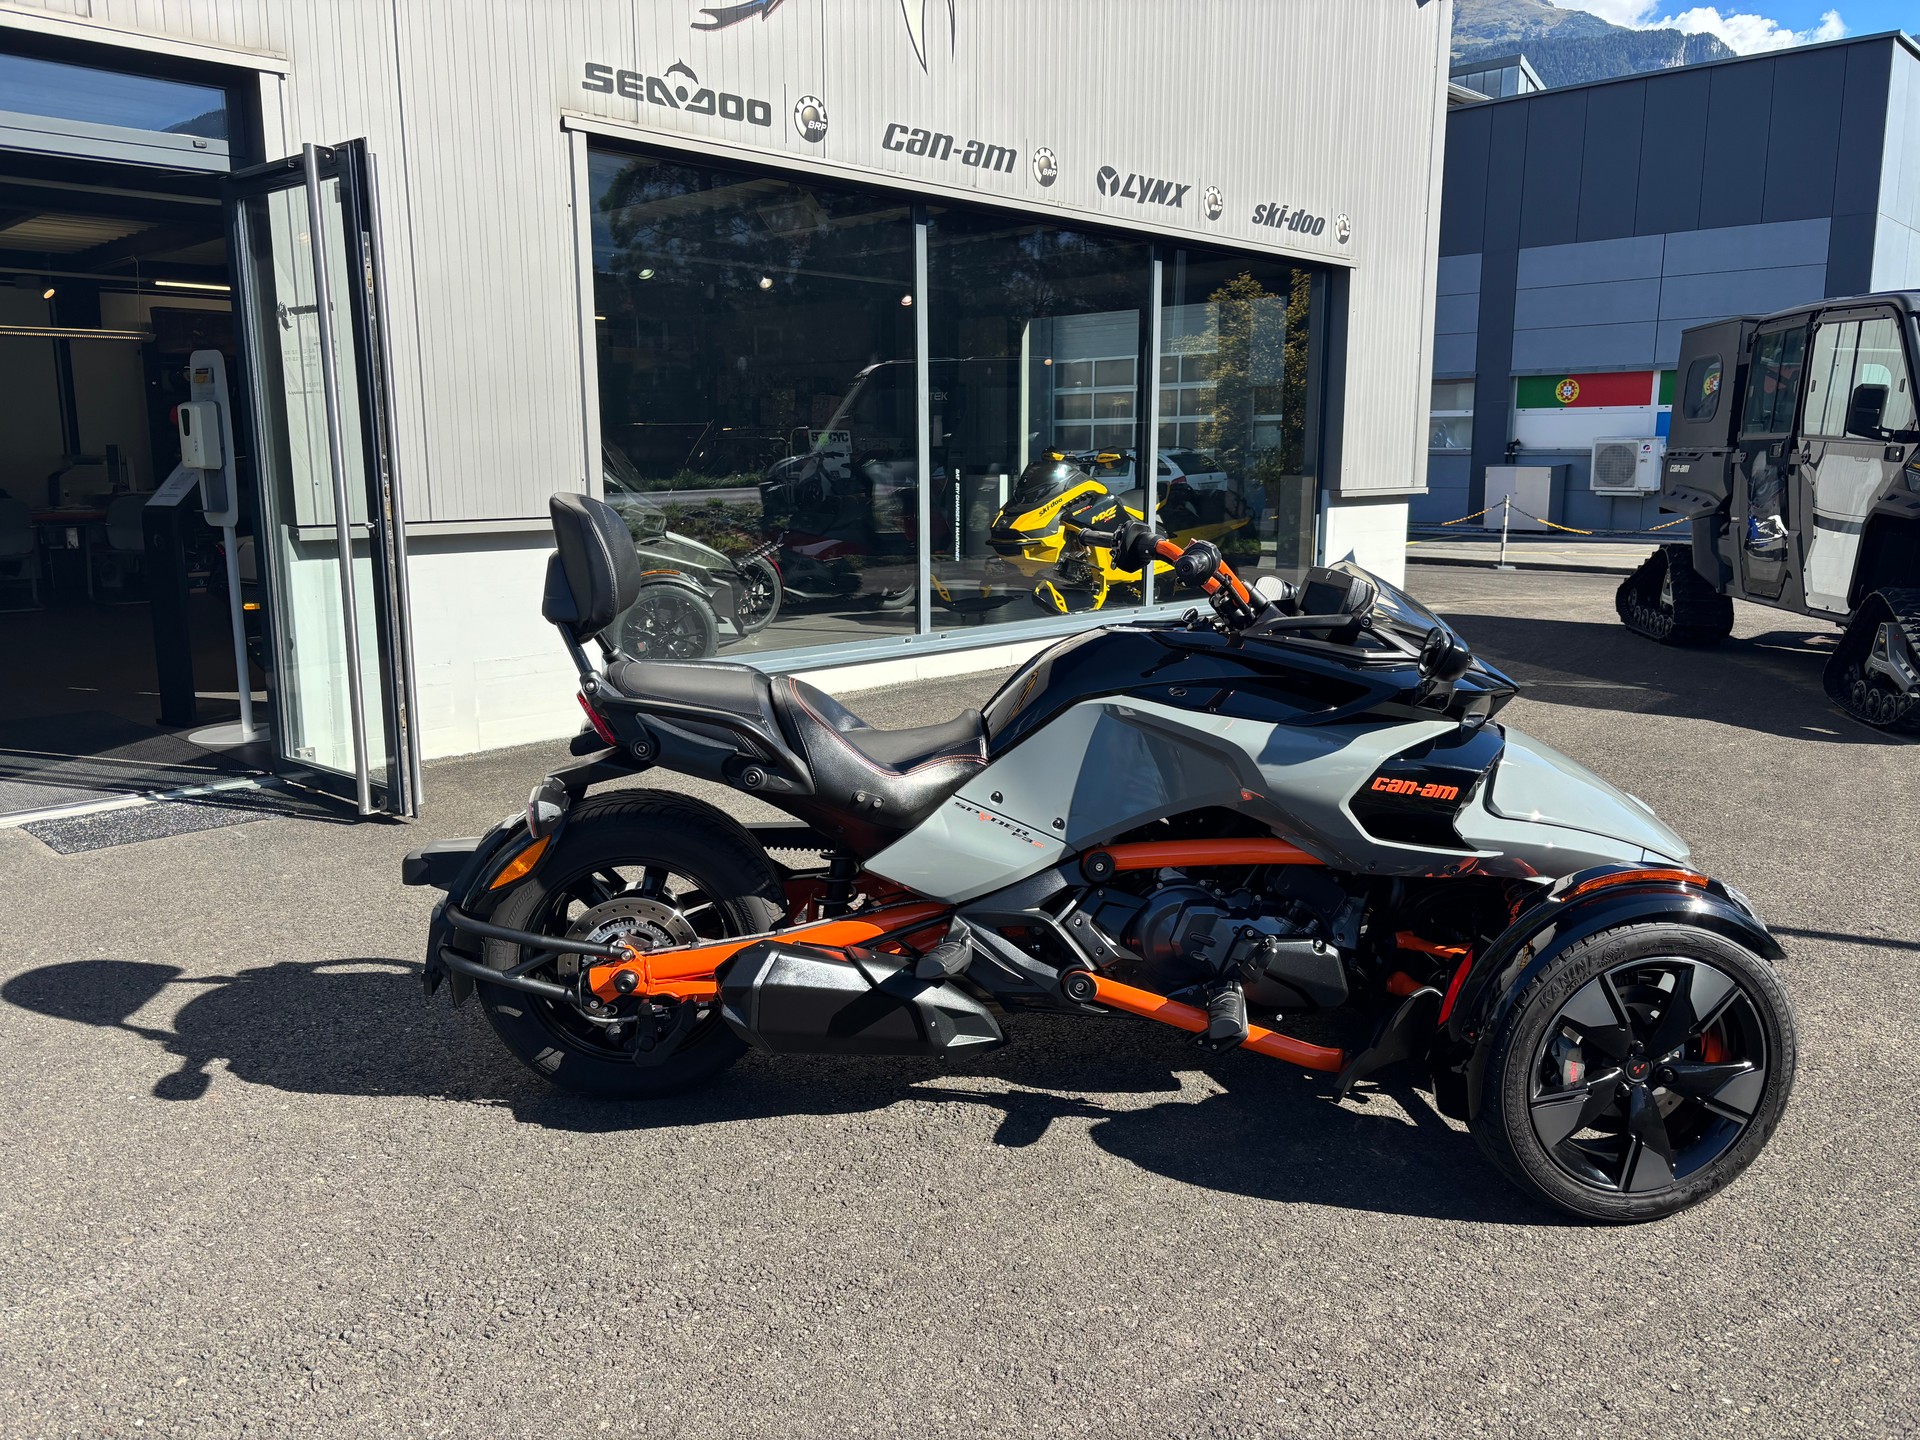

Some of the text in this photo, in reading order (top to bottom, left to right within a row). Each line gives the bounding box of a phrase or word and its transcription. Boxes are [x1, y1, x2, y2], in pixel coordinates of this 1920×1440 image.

[808, 120, 827, 131] BRP
[882, 123, 1017, 173] can-am
[1042, 168, 1057, 177] BRP
[1119, 173, 1192, 208] LYNX
[1251, 202, 1326, 236] ski-doo
[929, 391, 949, 401] TEK
[811, 431, 849, 442] SCYC
[1669, 464, 1691, 473] can-am
[1038, 497, 1063, 517] ski-doo
[1091, 504, 1118, 525] MXZ
[1371, 776, 1459, 800] can-am
